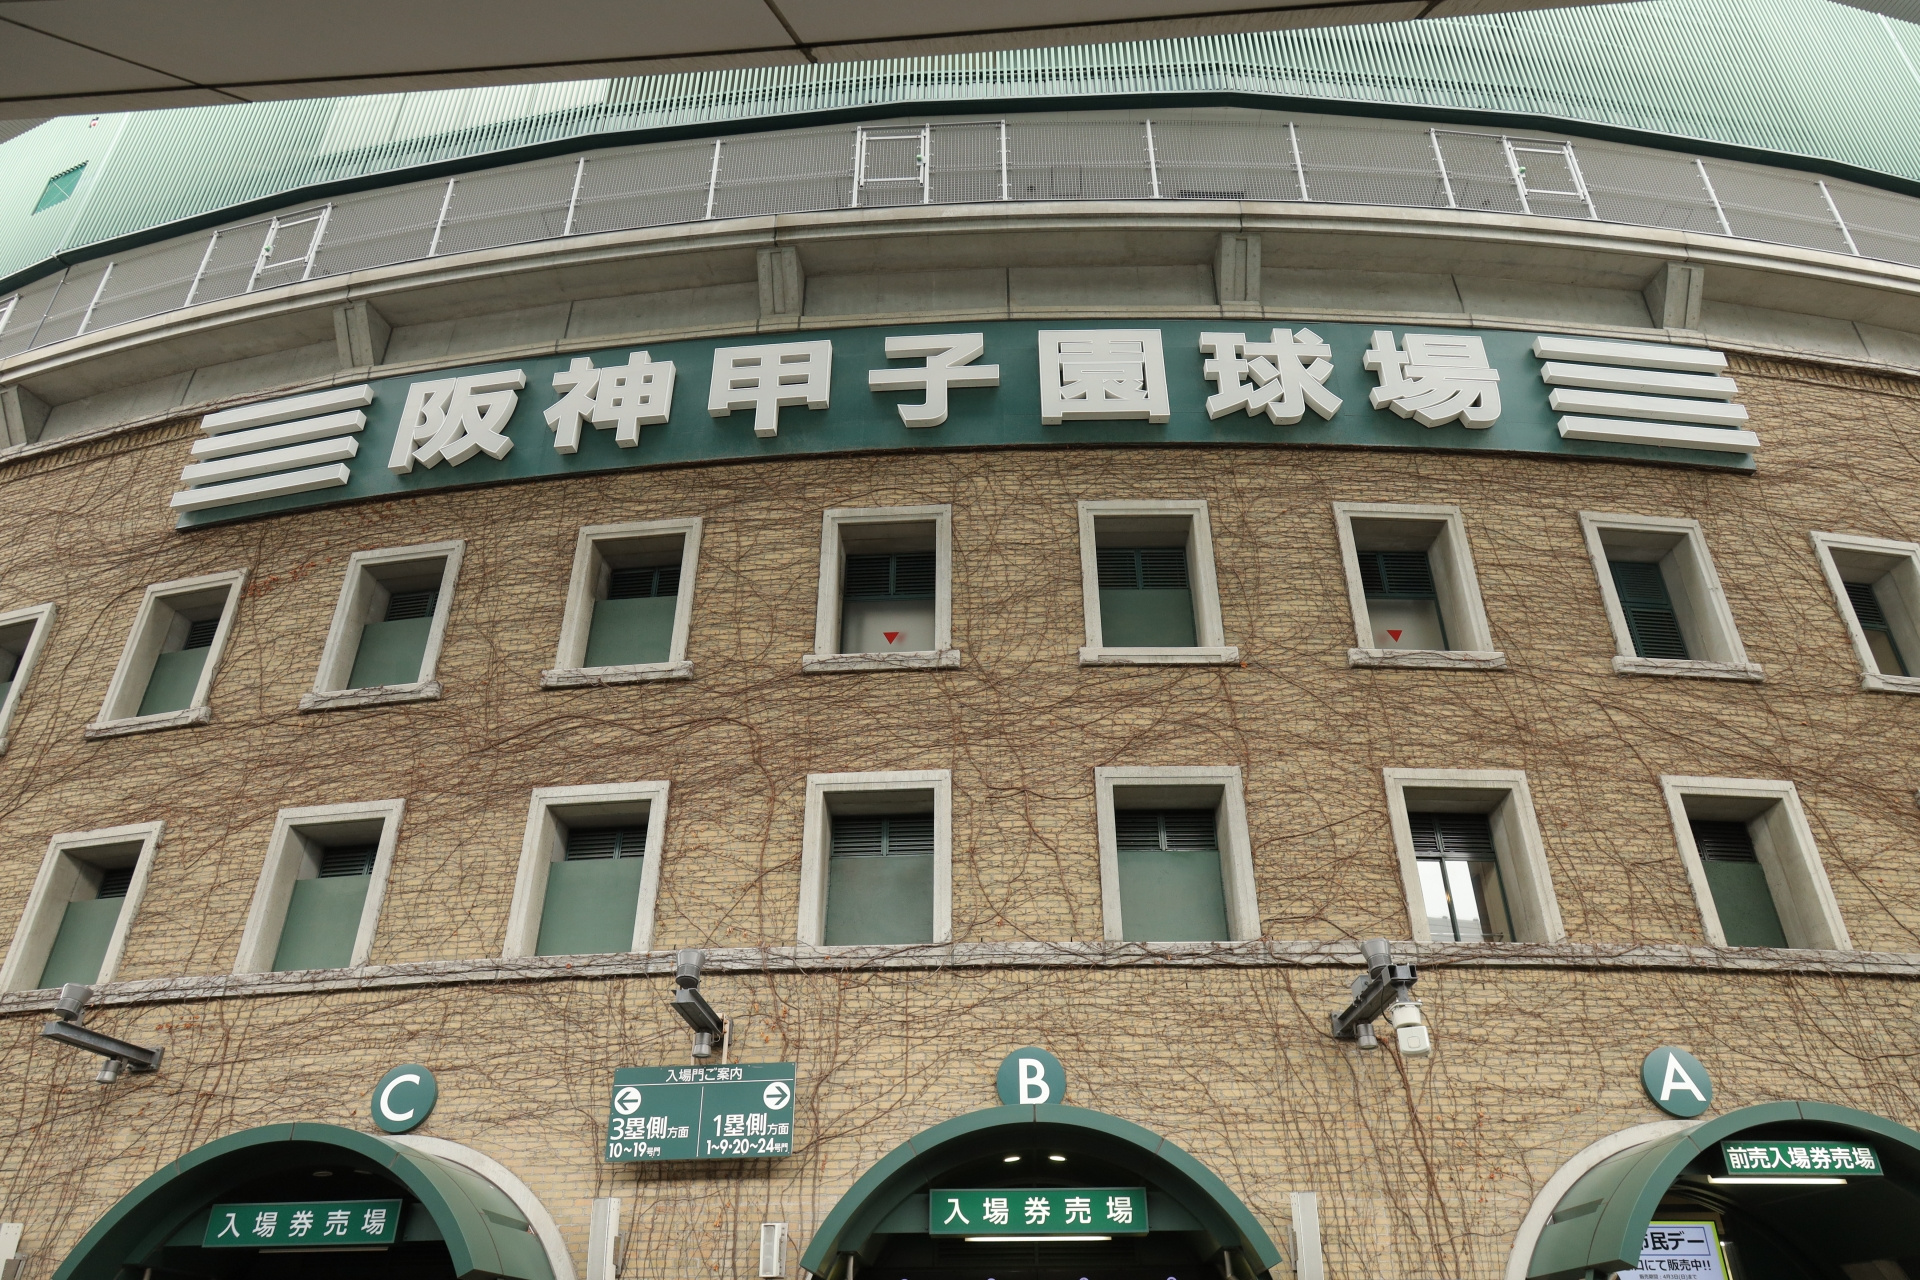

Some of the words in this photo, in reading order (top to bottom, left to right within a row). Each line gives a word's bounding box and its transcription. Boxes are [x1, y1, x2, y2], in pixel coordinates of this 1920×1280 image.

[387, 327, 1502, 475] 阪神甲子園球場
[665, 1066, 743, 1083] 入場門ご案内
[1018, 1058, 1050, 1105] B
[1660, 1051, 1707, 1102] A
[380, 1073, 421, 1122] C
[610, 1115, 690, 1140] 3塁側方面
[713, 1113, 790, 1137] 1塁側方面
[1726, 1146, 1877, 1170] 前売入場券売場
[217, 1208, 387, 1239] 入場券売場
[943, 1196, 1133, 1225] 入場券売場
[1631, 1259, 1712, 1271] 口にて販売中!!
